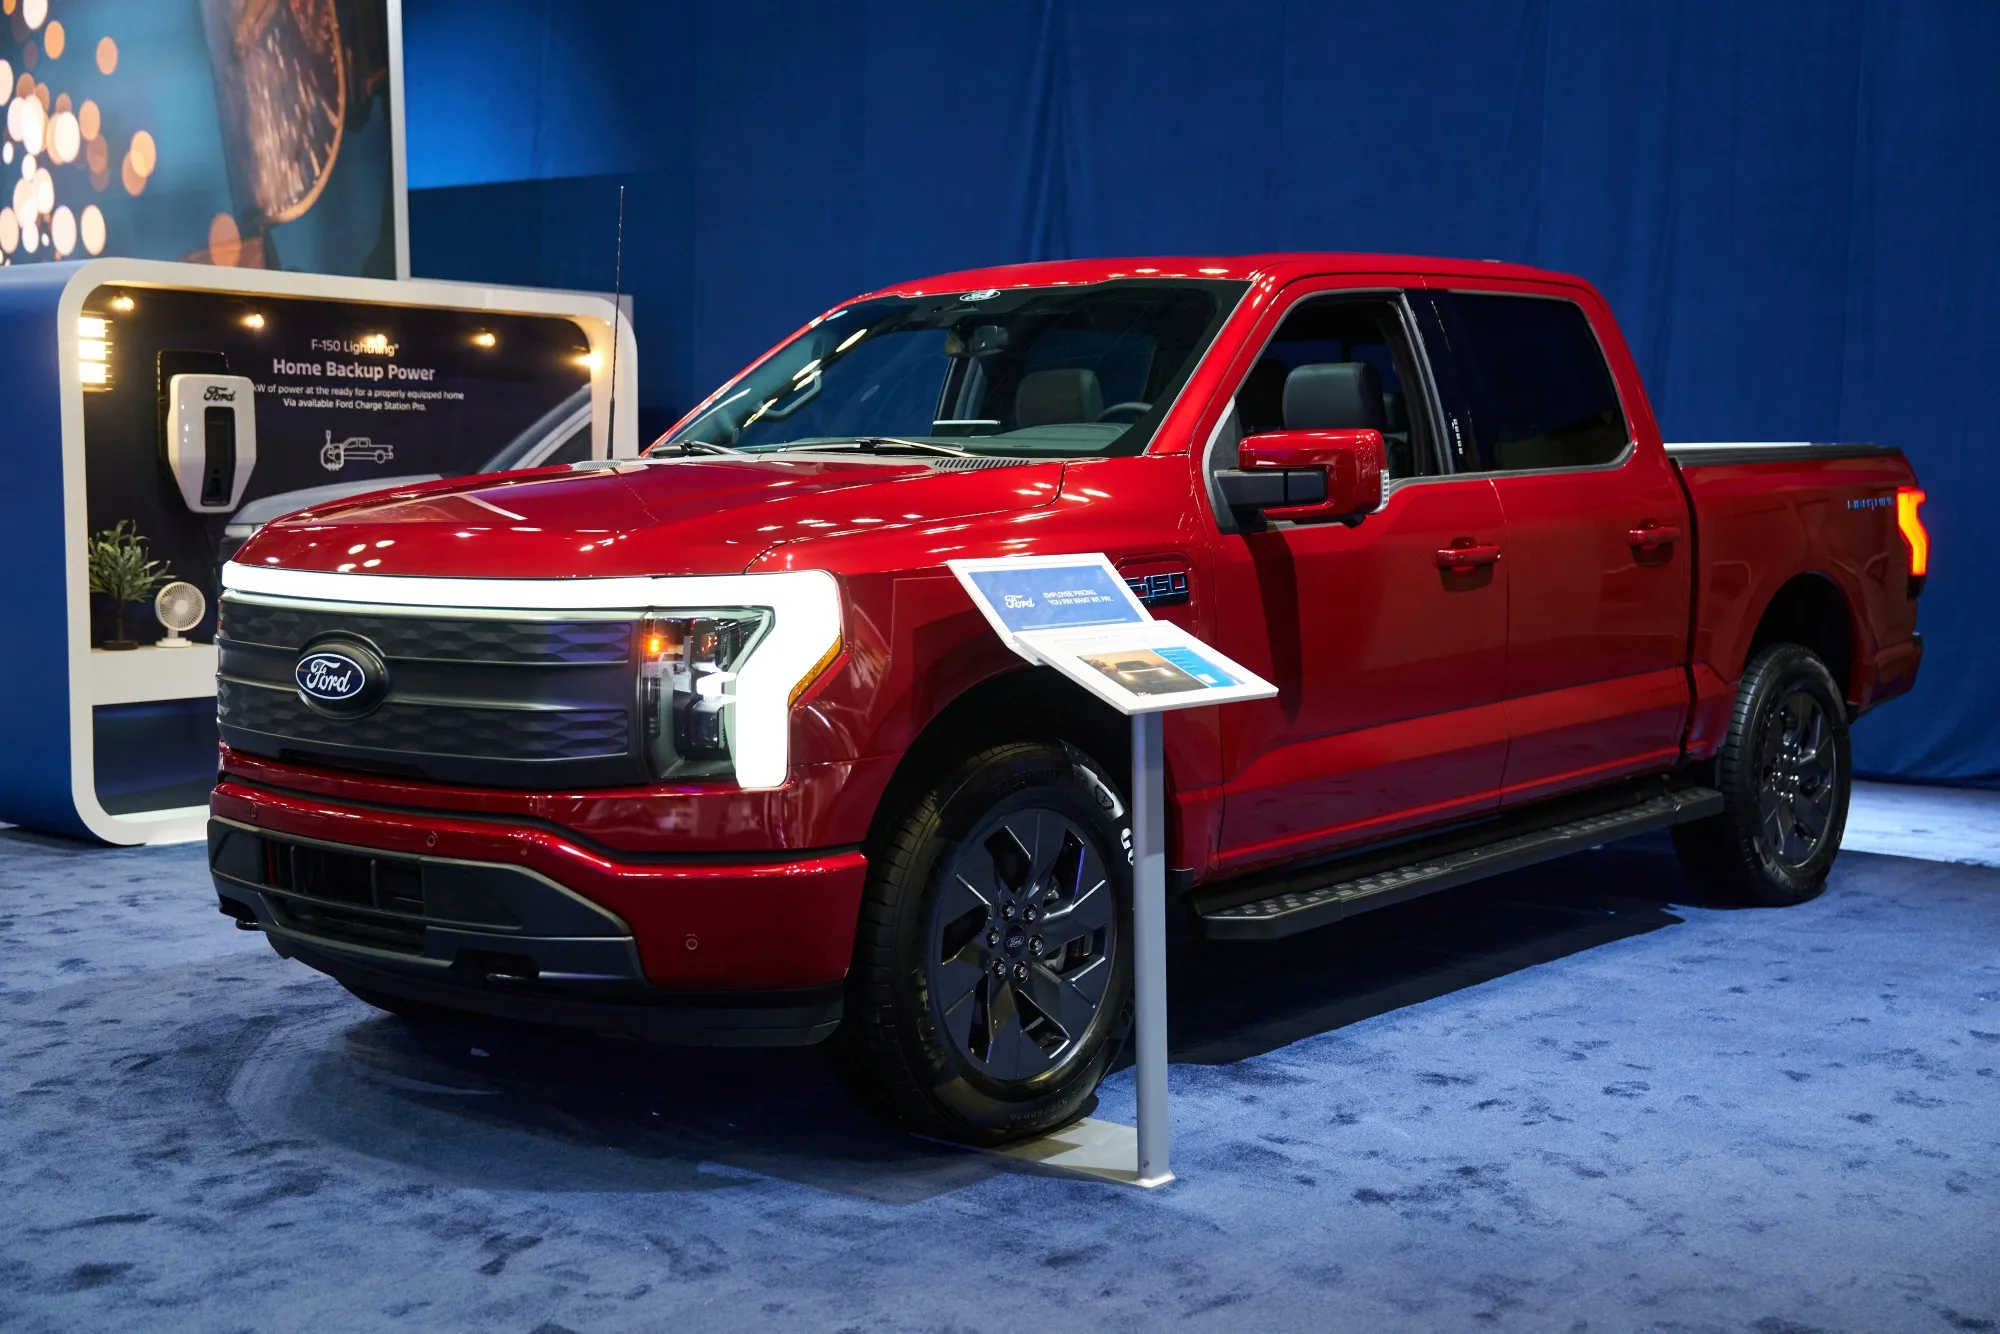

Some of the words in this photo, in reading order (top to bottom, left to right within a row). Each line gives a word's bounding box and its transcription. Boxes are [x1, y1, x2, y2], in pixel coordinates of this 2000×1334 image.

[311, 339, 341, 352] F-150
[273, 358, 322, 376] Home
[326, 361, 384, 382] Backup
[388, 364, 436, 381] Power
[203, 386, 236, 402] Ford
[267, 384, 277, 393] of
[278, 386, 304, 395] power
[305, 386, 314, 395] at
[316, 386, 330, 395] the
[331, 387, 354, 397] ready
[355, 387, 366, 397] for
[367, 389, 373, 397] a
[374, 388, 406, 399] properly
[407, 390, 442, 401] equipped
[443, 390, 465, 400] home
[283, 397, 297, 407] Via
[298, 398, 334, 409] available
[335, 399, 354, 409] Ford
[355, 400, 383, 411] Charge
[384, 401, 411, 411] Station
[1004, 594, 1036, 609] Ford
[306, 658, 352, 693] Ford
